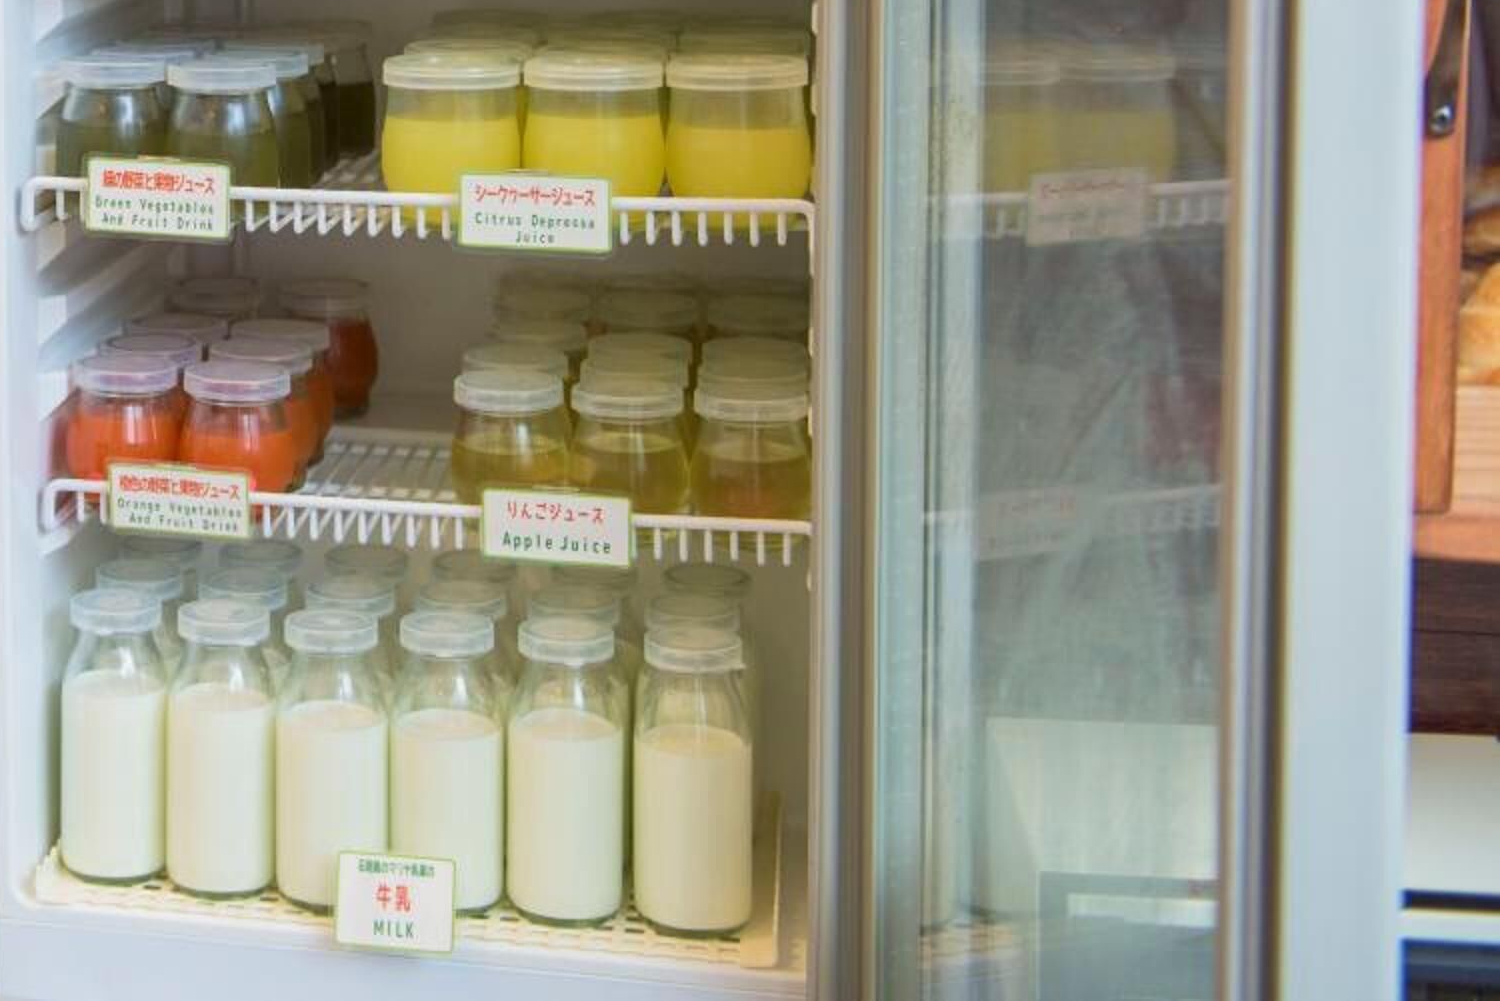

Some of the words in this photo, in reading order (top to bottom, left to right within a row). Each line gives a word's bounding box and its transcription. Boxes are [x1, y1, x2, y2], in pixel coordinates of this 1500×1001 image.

[95, 195, 132, 209] Green
[139, 199, 214, 215] Vegetables
[101, 212, 123, 226] And
[131, 214, 168, 228] Fruit
[177, 216, 213, 230] Drink
[474, 211, 522, 227] Citrus
[531, 214, 596, 230] Depressa
[515, 230, 556, 244] Juice
[117, 497, 161, 512] Orange
[169, 502, 243, 518] Vegetables
[507, 501, 606, 524] りんごジュース
[128, 512, 151, 525] And
[159, 514, 195, 528] Fruit
[202, 519, 239, 533] Drink
[502, 531, 554, 550] Apple
[559, 536, 612, 555] Juice
[375, 880, 412, 913] 牛乳
[373, 919, 414, 939] MILK
